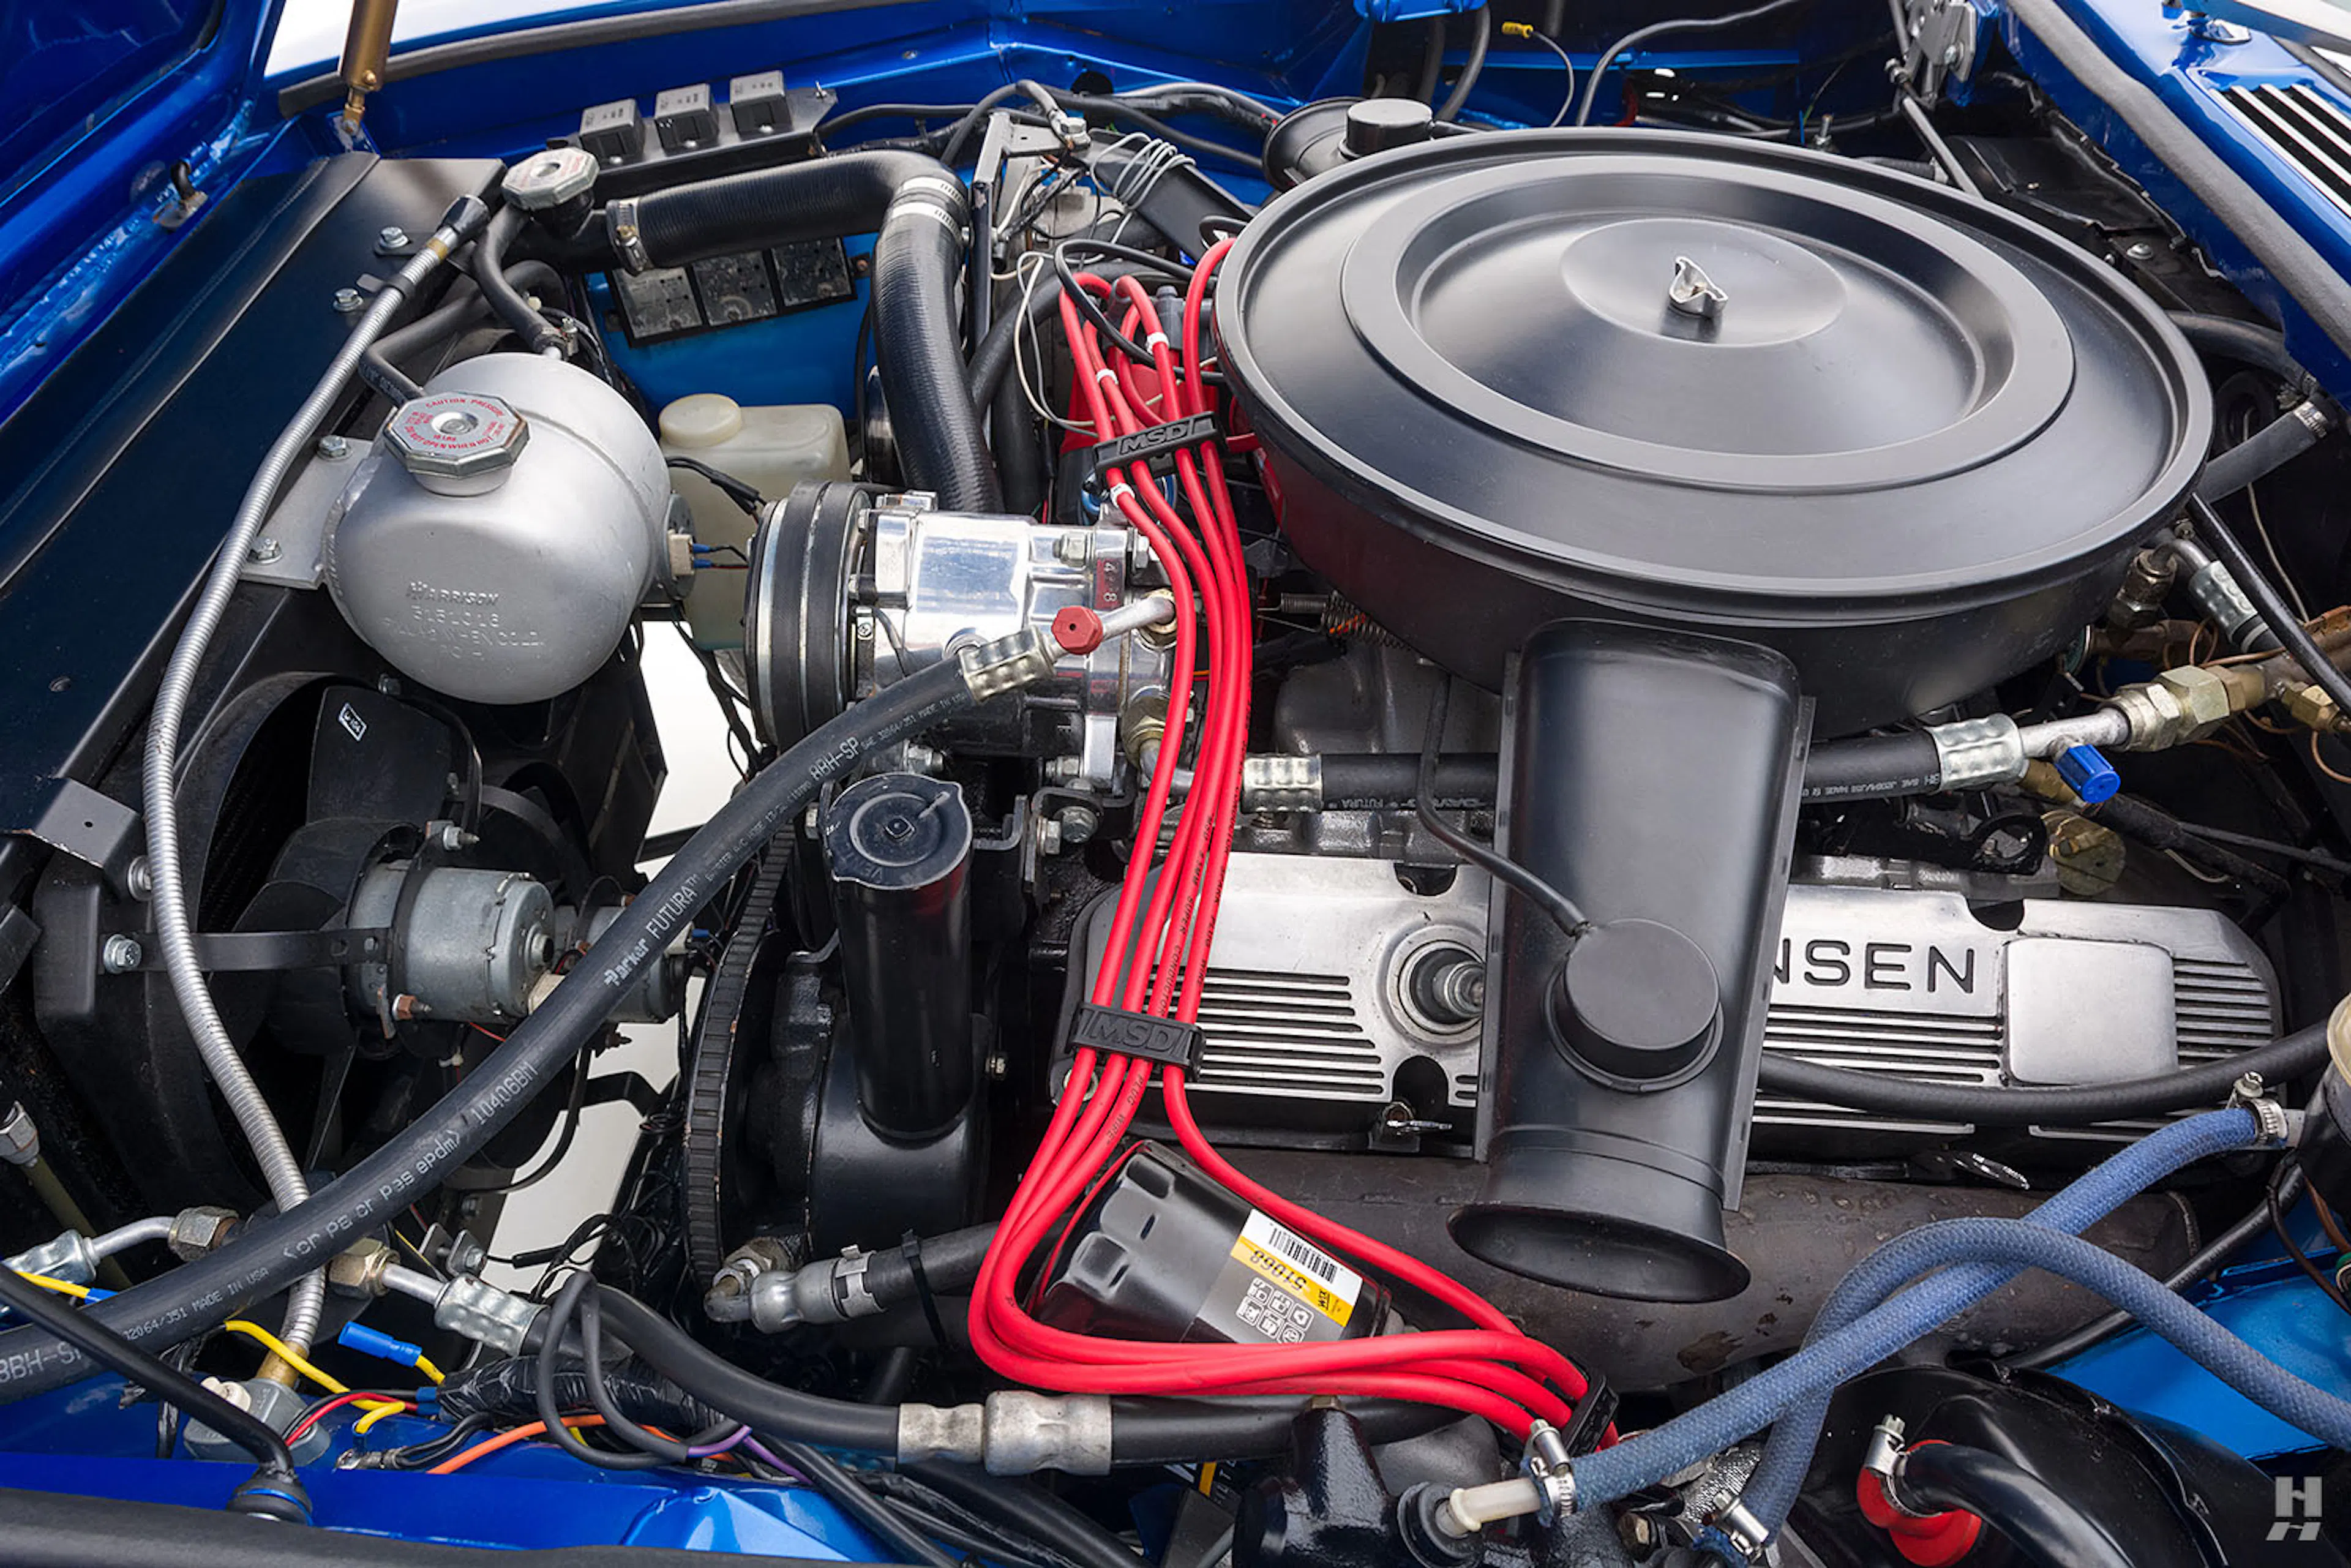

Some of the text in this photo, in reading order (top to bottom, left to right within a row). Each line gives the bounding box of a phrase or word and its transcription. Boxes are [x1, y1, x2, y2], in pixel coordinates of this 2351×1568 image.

[1120, 423, 1187, 455] MSD
[407, 581, 499, 606] HARRISON
[1179, 896, 1193, 934] SUPER
[1158, 945, 1181, 1016] CONDUCTOR
[1090, 1013, 1174, 1052] MSD
[1127, 1073, 1144, 1106] PLUG
[191, 1290, 223, 1312] MADE
[227, 1280, 244, 1296] IN
[245, 1267, 270, 1285] USA
[1249, 1249, 1307, 1292] 51068
